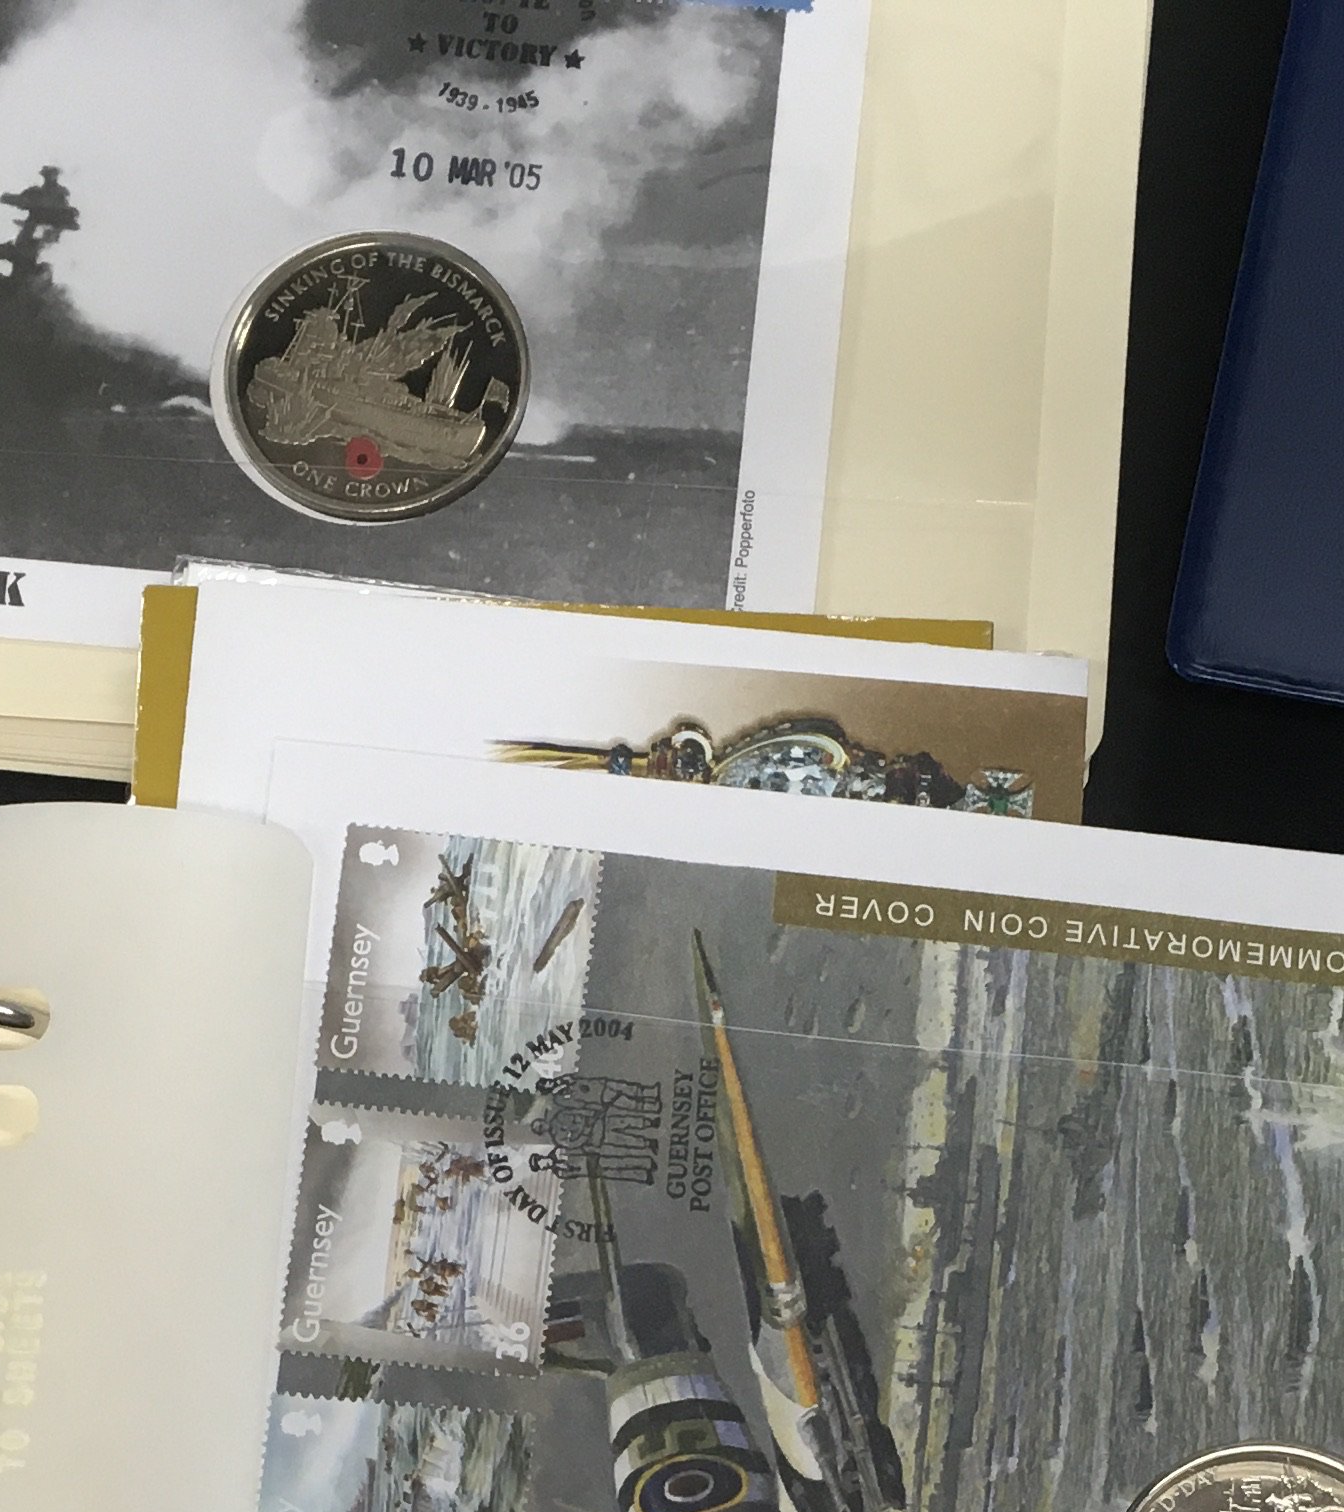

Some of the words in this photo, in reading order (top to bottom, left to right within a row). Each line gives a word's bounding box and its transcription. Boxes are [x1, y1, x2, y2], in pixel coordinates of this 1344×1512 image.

[483, 11, 519, 34] TO
[438, 34, 557, 66] VICTORY
[390, 148, 433, 182] 10
[448, 154, 497, 188] MAR
[503, 159, 542, 191] '05
[264, 258, 345, 323] SINKING
[351, 252, 378, 270] OF
[387, 252, 424, 273] THE
[430, 262, 506, 346] BISMARCK
[292, 460, 337, 490] ONE
[345, 476, 430, 498] CROWN
[734, 490, 756, 568] Popperfoto
[815, 893, 935, 928] COVER
[963, 908, 1048, 941] COIN
[330, 924, 380, 1060] Guernsey
[525, 1021, 574, 1057] MAY
[578, 1018, 635, 1041] 2004
[503, 1053, 532, 1081] 12
[694, 1057, 719, 1143] OFFICE
[666, 1069, 694, 1199] GUERNSEY
[488, 1152, 514, 1184] OF
[690, 1147, 713, 1213] POST
[503, 1185, 548, 1224] DAY
[293, 1204, 343, 1343] Guernsey
[496, 1321, 531, 1363] 36
